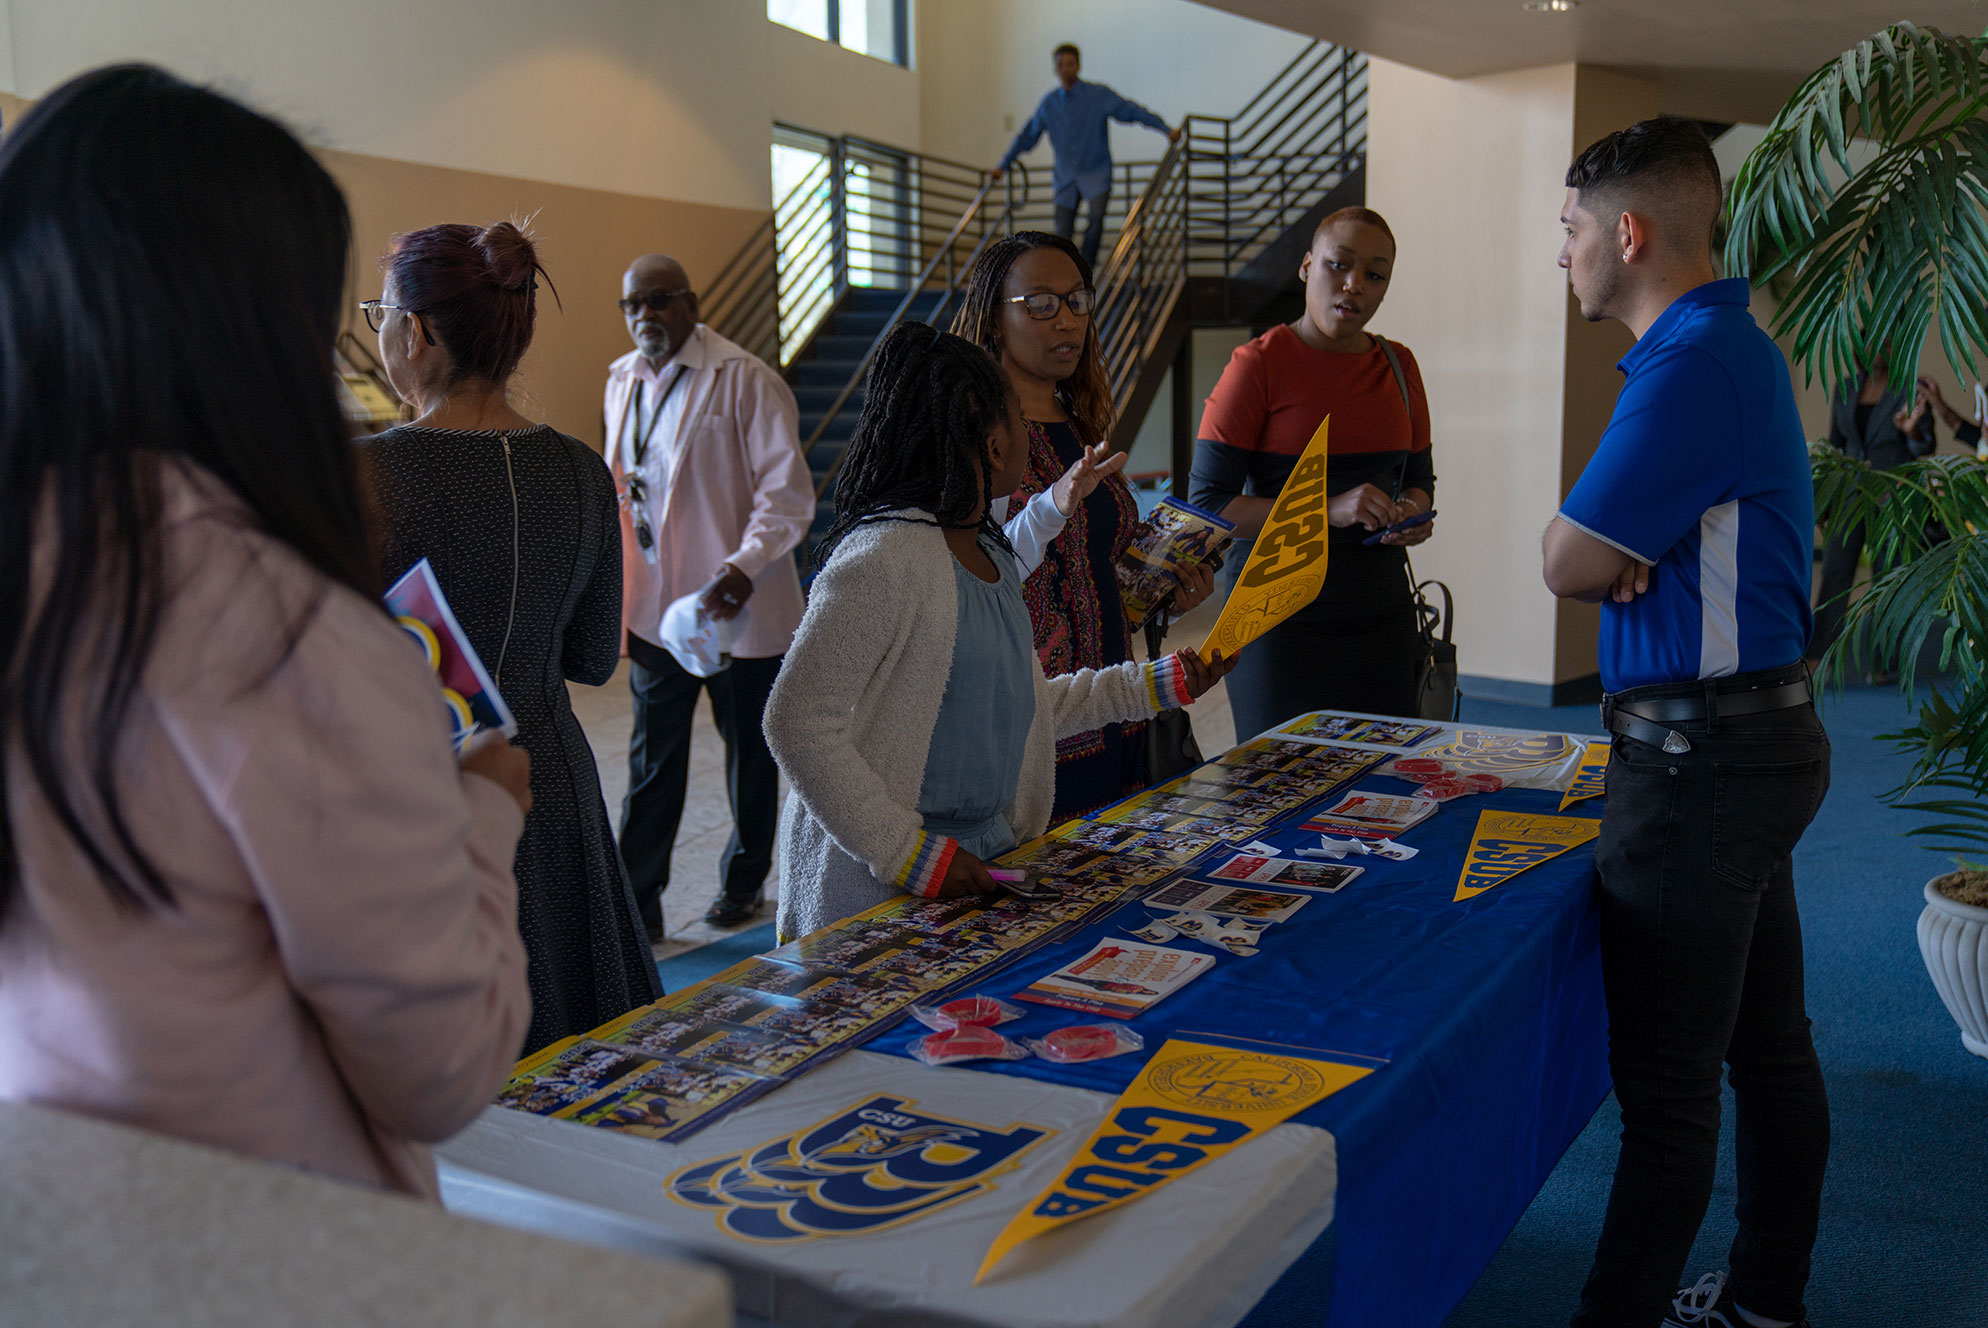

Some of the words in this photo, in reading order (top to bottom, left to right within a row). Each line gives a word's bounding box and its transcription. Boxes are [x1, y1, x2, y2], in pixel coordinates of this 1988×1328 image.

[1242, 453, 1326, 588] CSUB
[1464, 839, 1569, 889] CSUB
[857, 1108, 917, 1128] CSU
[1033, 1105, 1253, 1218] CSUB
